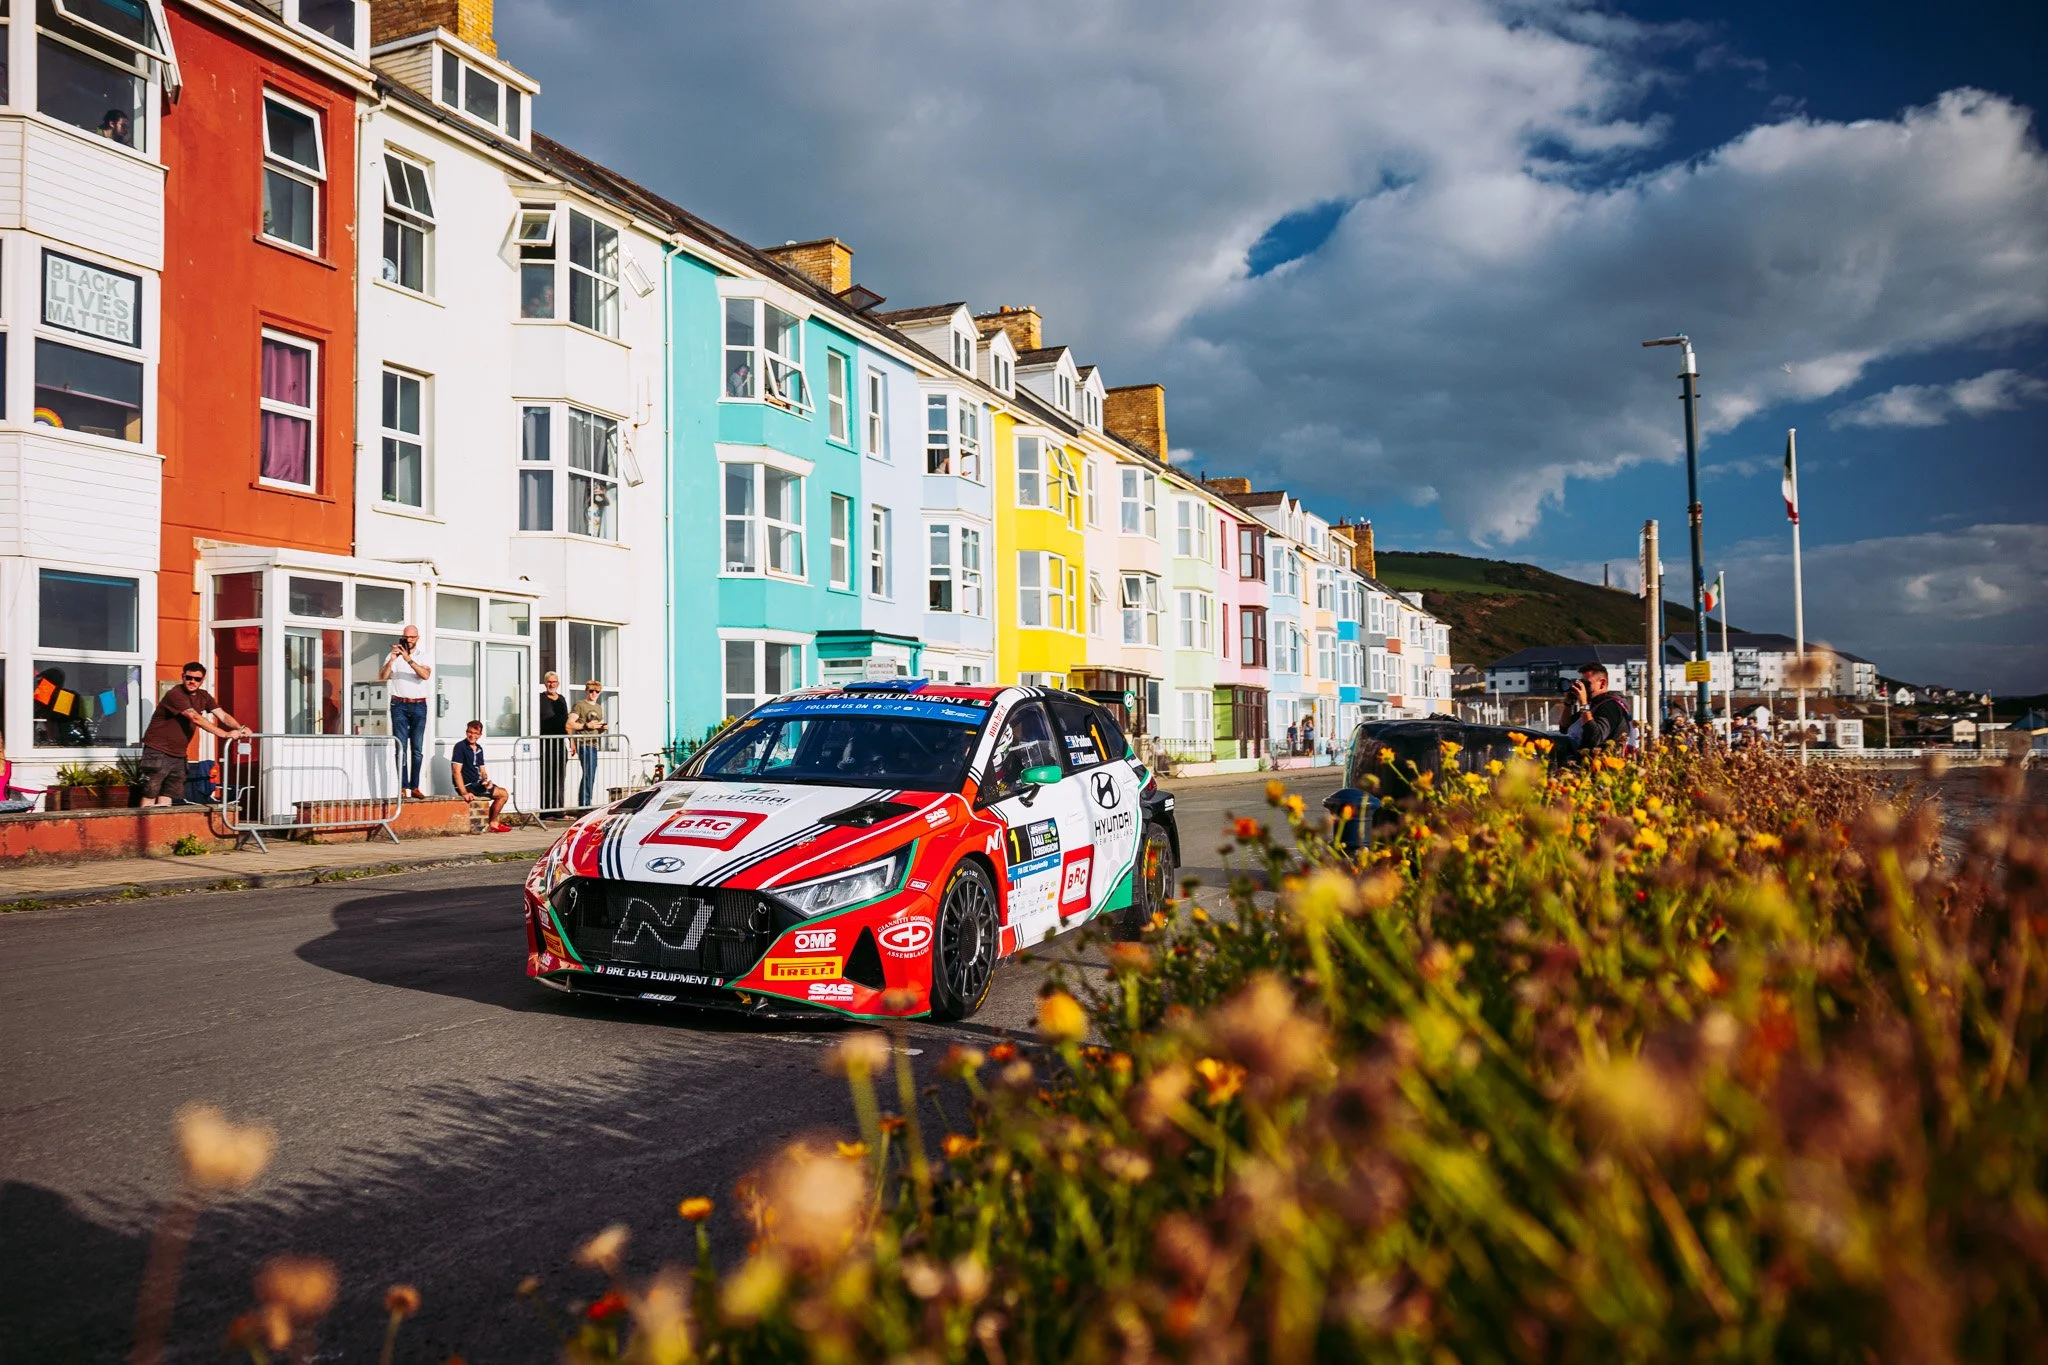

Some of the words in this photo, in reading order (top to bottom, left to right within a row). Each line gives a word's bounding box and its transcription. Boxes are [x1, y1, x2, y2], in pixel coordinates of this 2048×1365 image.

[51, 260, 120, 297] BLACK
[51, 280, 129, 319] LIVES
[48, 301, 129, 339] MATTER
[825, 692, 860, 700] GAS
[863, 693, 967, 704] EQUIPMENT
[1091, 724, 1108, 761] 1
[700, 794, 791, 804] HYUNDAI
[674, 818, 732, 831] BRC
[924, 807, 948, 824] SAS
[1094, 811, 1132, 838] HYUNDAI
[1010, 829, 1021, 863] 1
[1067, 867, 1086, 889] BRC
[795, 933, 837, 949] OMP
[606, 966, 625, 976] BRC
[627, 968, 648, 979] GAS
[650, 971, 709, 985] EQUIPMENT
[771, 962, 836, 976] PIRELLI
[808, 983, 854, 995] SAS
